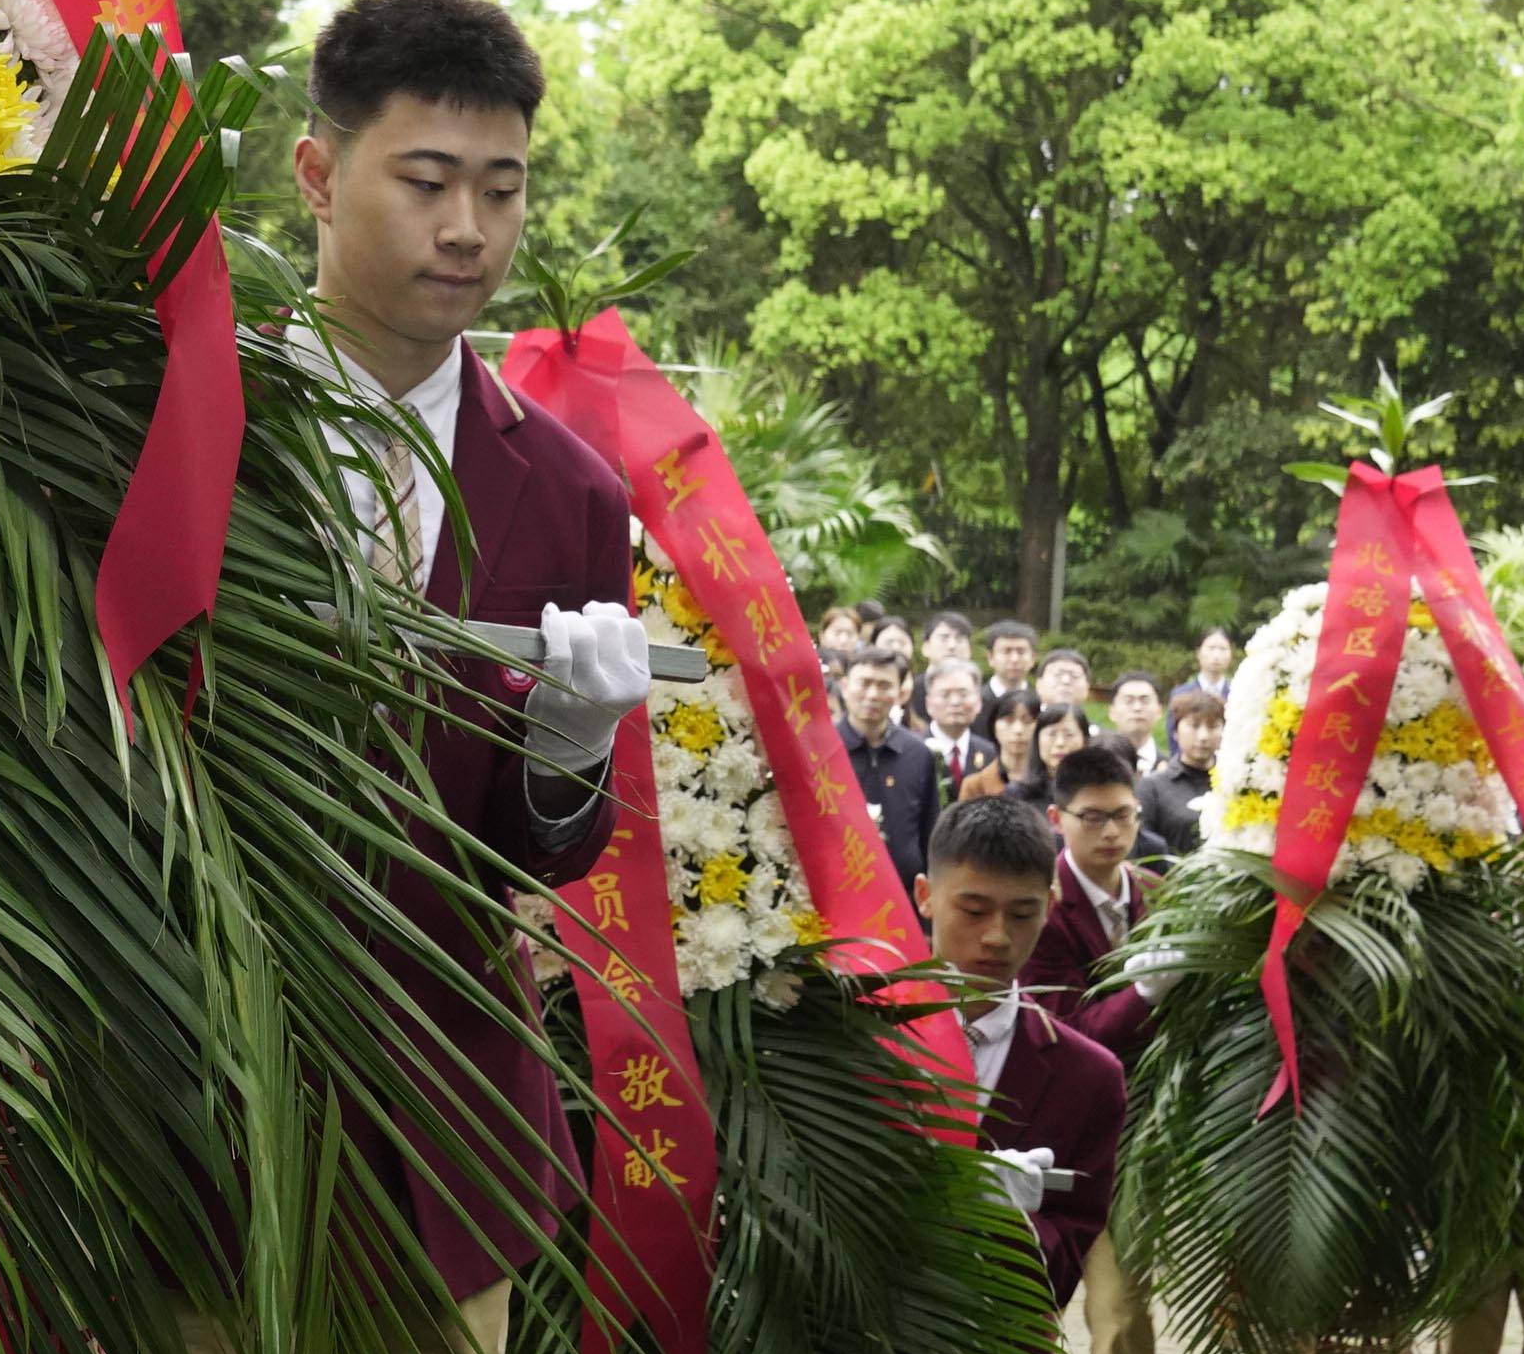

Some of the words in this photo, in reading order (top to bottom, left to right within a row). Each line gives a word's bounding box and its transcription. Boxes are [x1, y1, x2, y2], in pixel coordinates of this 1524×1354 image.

[1297, 542, 1394, 844] 北碚区人民政府
[619, 1053, 690, 1188] 敬献
